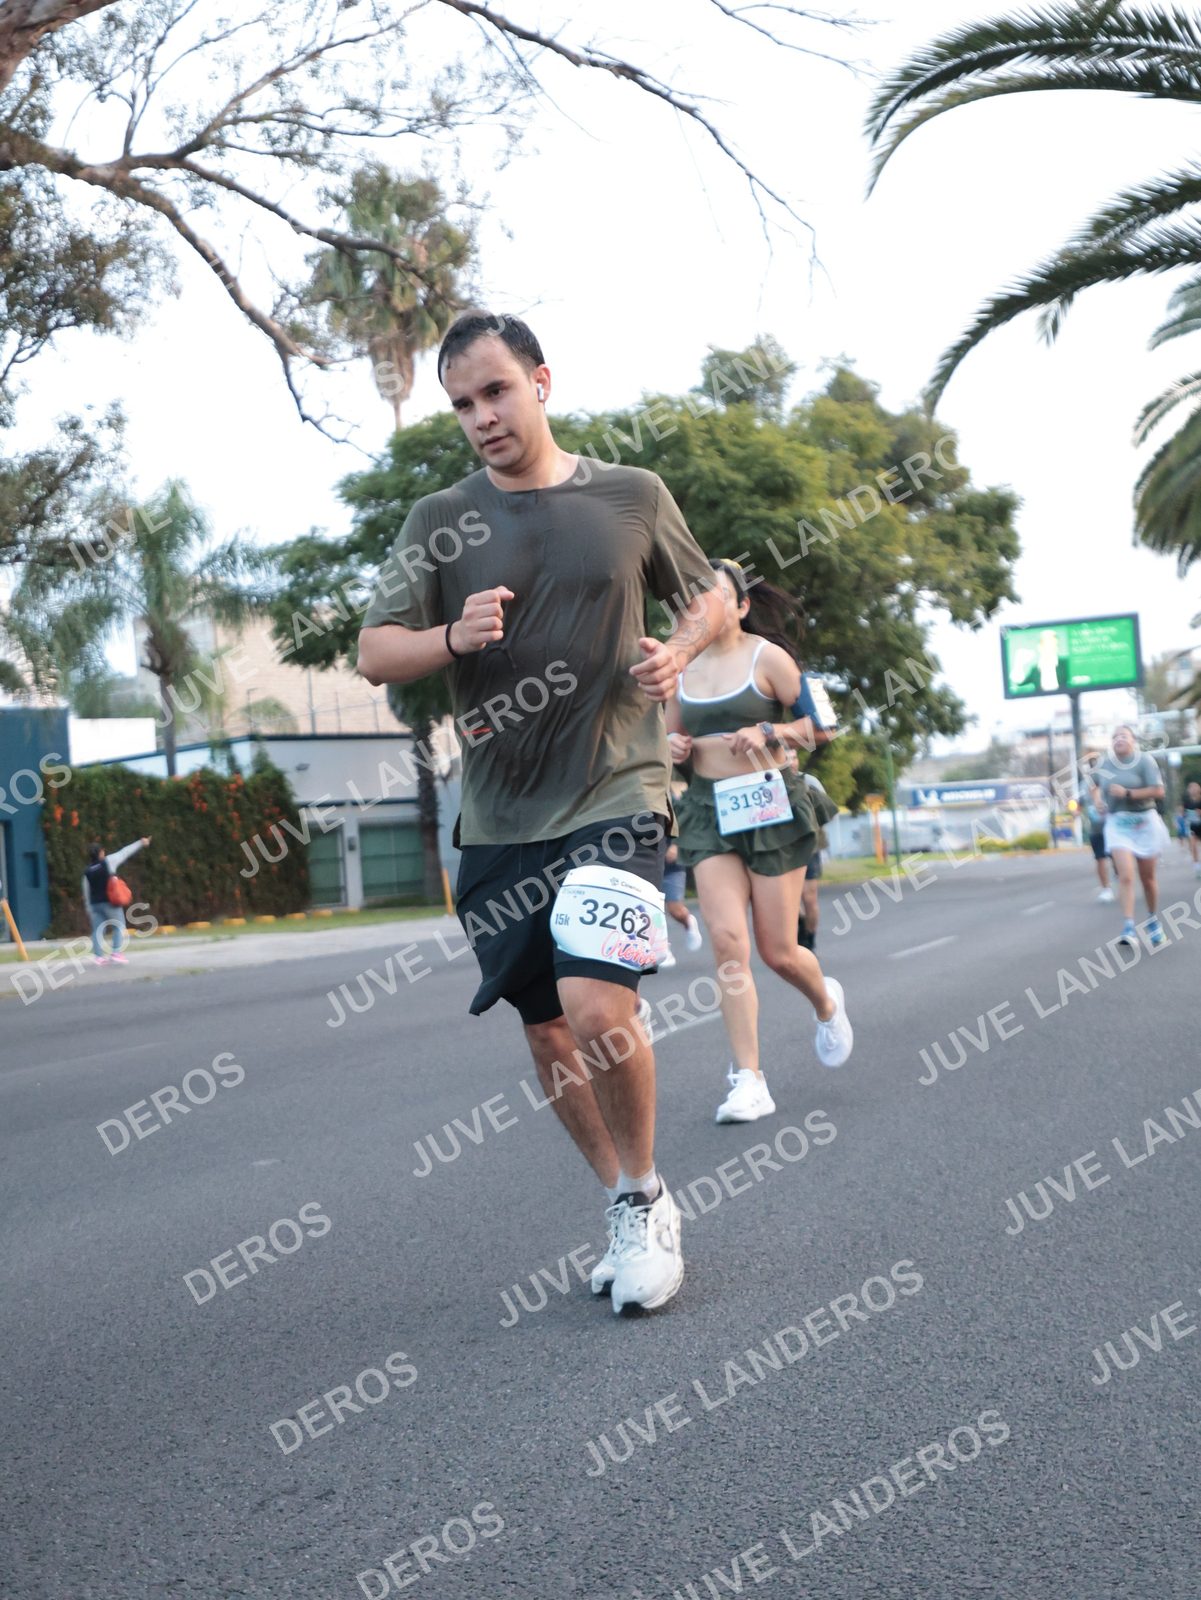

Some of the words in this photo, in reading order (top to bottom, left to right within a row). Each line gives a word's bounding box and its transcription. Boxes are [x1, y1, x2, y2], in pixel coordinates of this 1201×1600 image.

[729, 788, 773, 811] 3199
[555, 913, 570, 926] 15k
[579, 899, 651, 941] 3262
